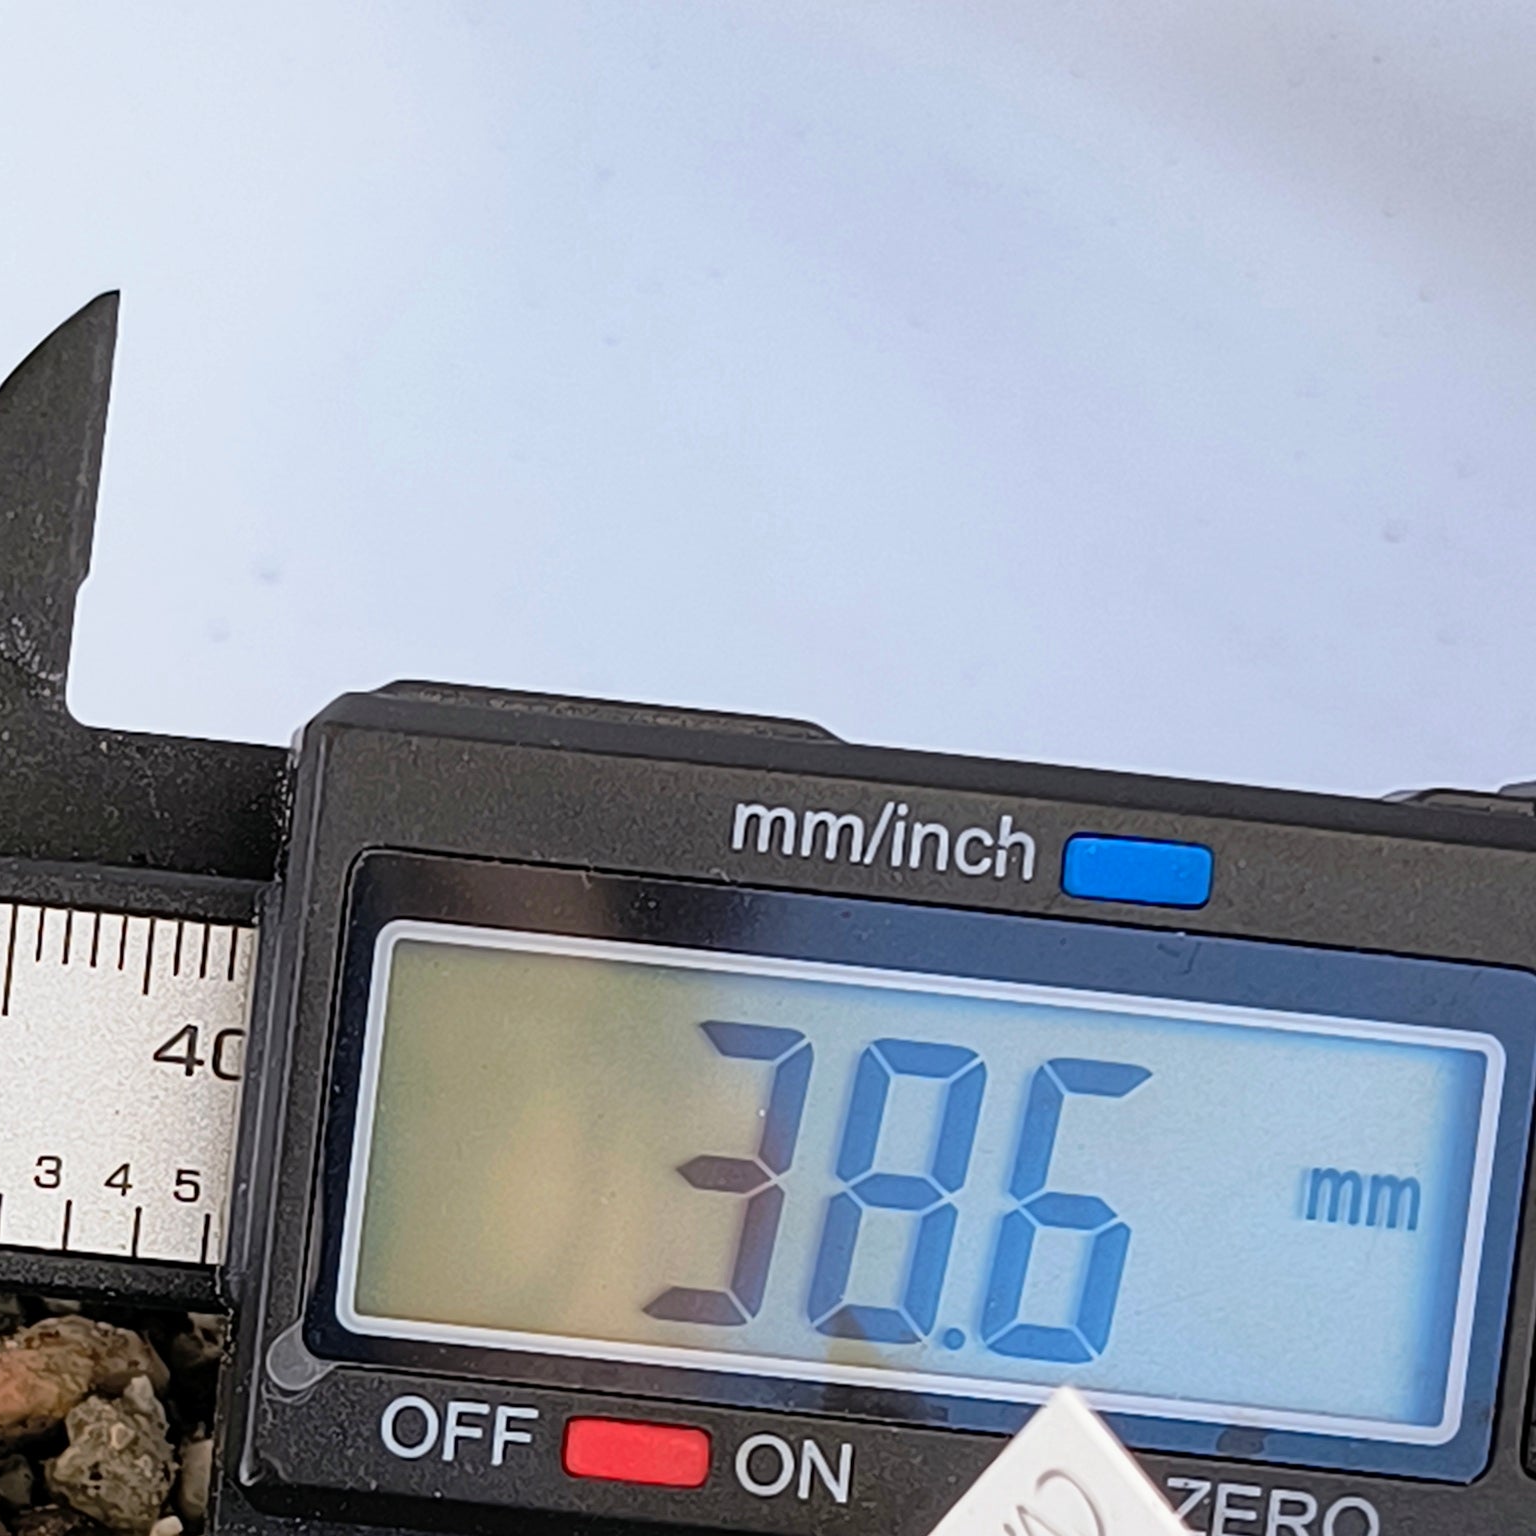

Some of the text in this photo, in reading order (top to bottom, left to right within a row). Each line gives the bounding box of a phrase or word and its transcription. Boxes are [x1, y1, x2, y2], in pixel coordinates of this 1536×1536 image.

[730, 800, 1036, 883] mm/inch
[33, 1155, 63, 1189] 3
[104, 1163, 134, 1197] 4
[172, 1170, 202, 1204] 5
[641, 1018, 1423, 1365] 38.6 mm
[378, 1393, 541, 1469] OFF
[734, 1433, 855, 1505] ON
